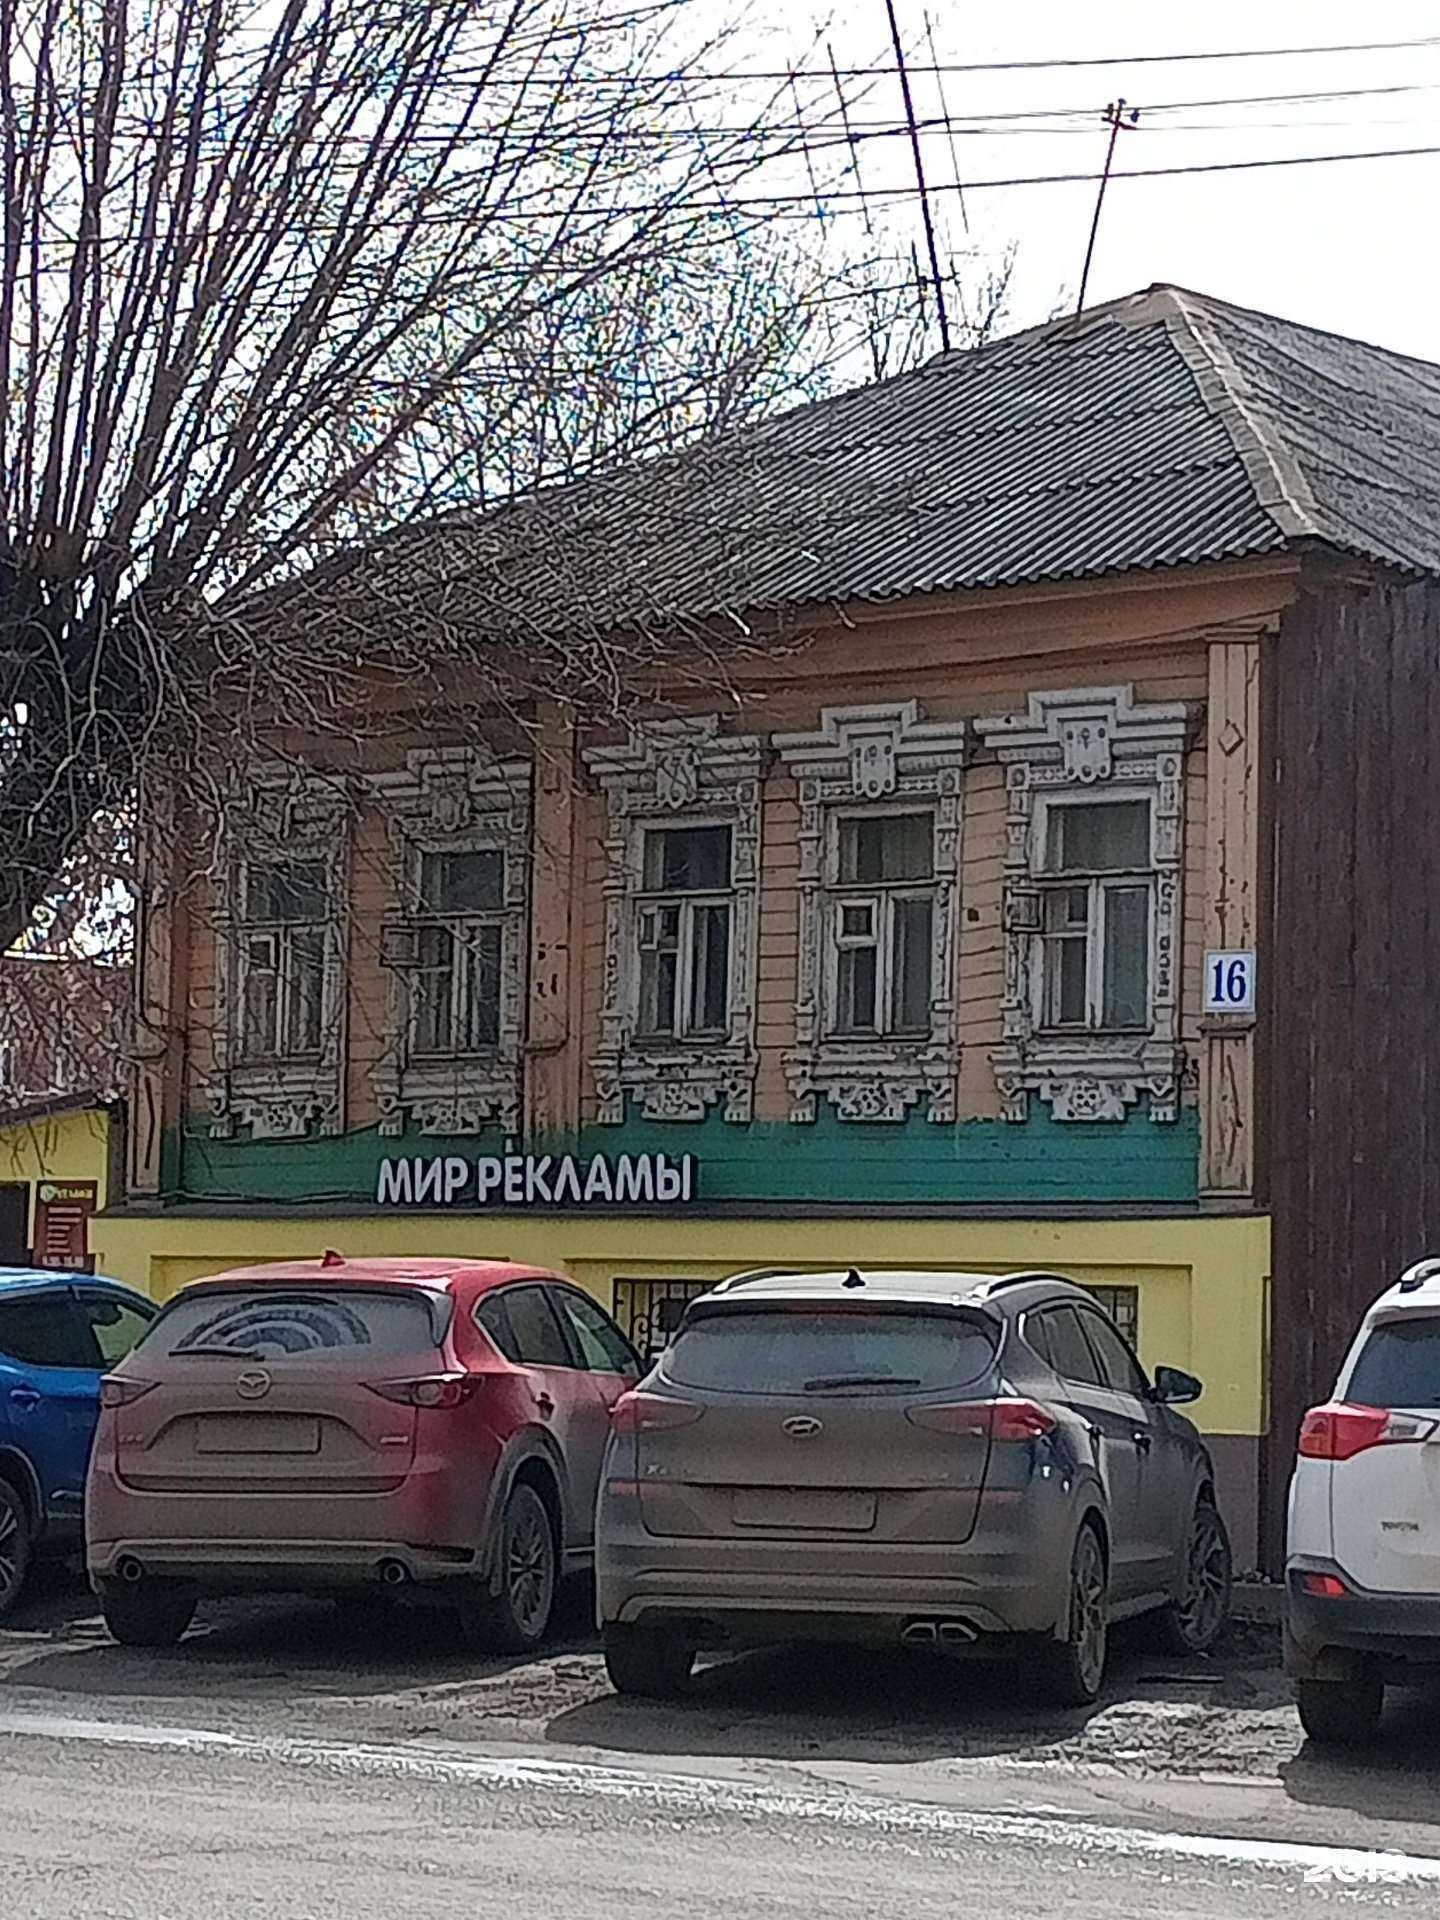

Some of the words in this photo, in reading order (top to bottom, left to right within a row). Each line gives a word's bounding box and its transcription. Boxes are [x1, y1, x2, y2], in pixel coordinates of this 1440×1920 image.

[1211, 959, 1246, 1002] 16
[377, 1156, 469, 1202] МИР
[478, 1153, 691, 1201] РЕКЛАМЫ
